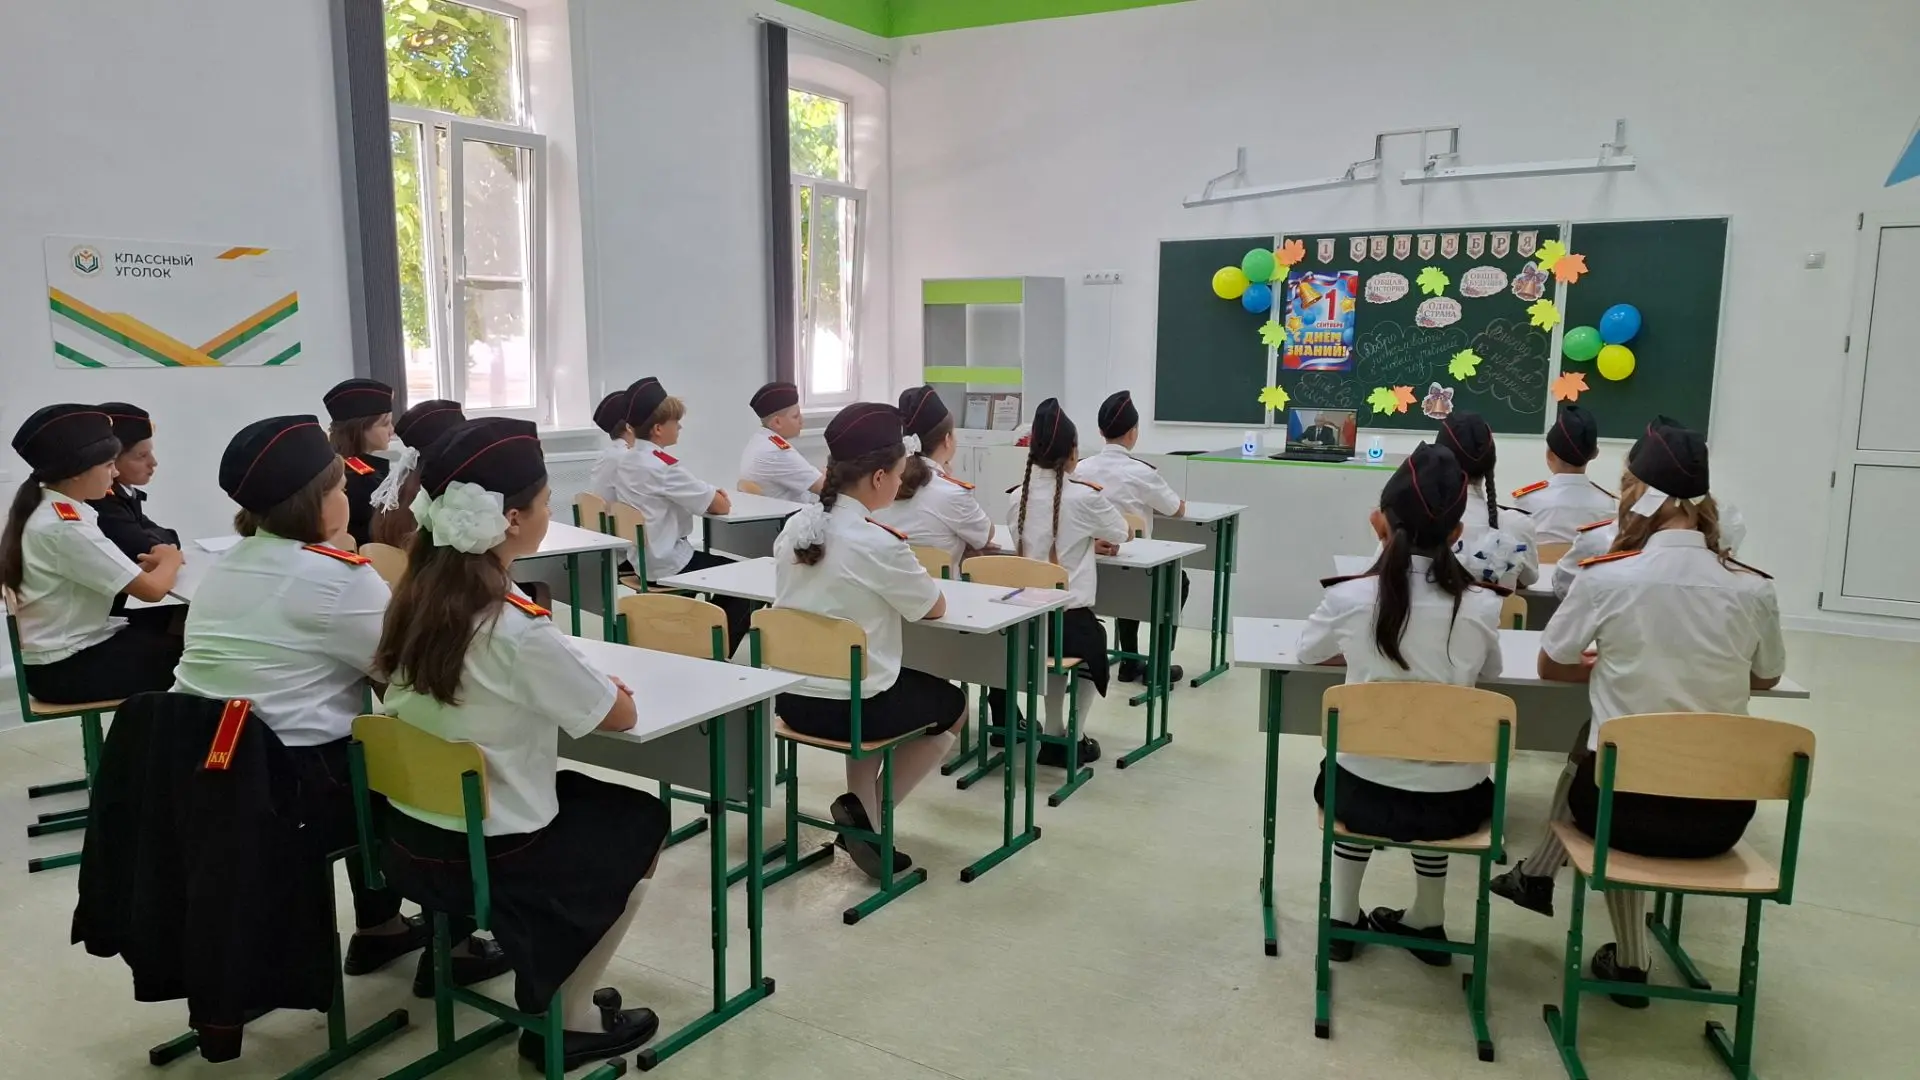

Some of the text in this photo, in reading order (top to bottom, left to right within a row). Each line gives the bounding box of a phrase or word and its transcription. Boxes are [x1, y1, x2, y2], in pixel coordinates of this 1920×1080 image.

[1354, 236, 1532, 252] СЕНТЯБРЯ
[114, 252, 194, 266] КЛАССНЫЙ
[115, 266, 172, 278] УГОЛОК
[1325, 288, 1337, 321] 1
[1429, 302, 1454, 310] ОДНА
[1424, 310, 1457, 318] СТРАНА
[1294, 331, 1342, 345] С ДНЕМ
[1287, 342, 1347, 357] ЗНАНИЙ!
